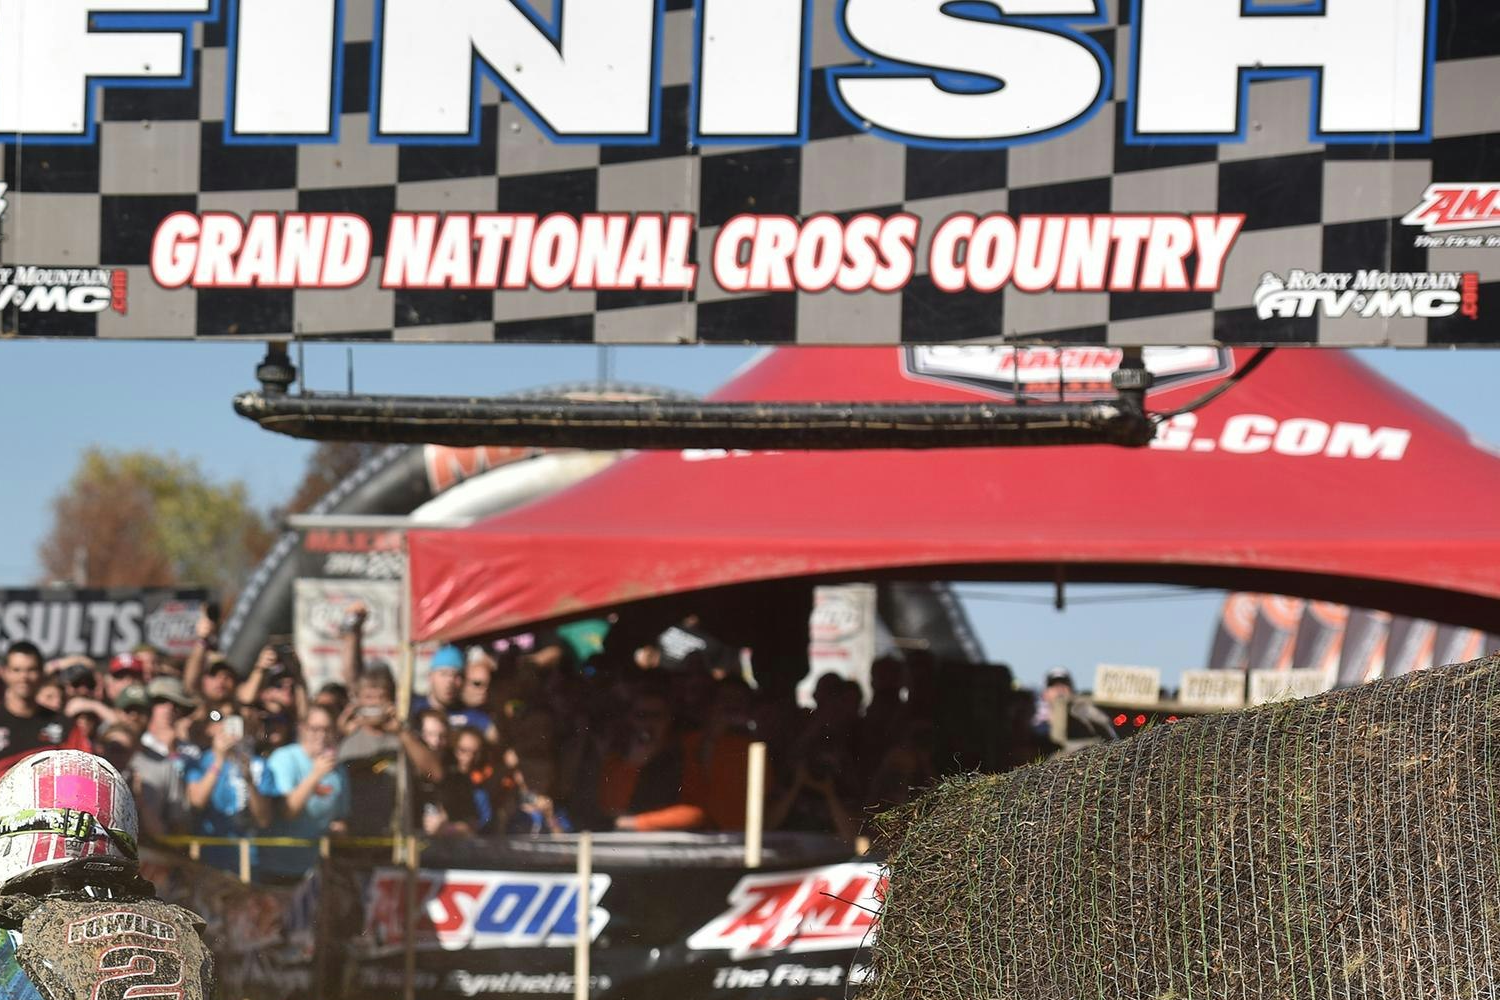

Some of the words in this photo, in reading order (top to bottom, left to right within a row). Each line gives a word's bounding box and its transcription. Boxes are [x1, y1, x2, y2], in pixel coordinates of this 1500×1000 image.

[150, 211, 372, 290] GRAND
[382, 212, 697, 291] NATIONAL
[712, 213, 922, 293] CROSS
[930, 213, 1247, 293] COUNTRY
[14, 265, 113, 286] MOUNTAIN
[1286, 269, 1352, 290] ROCKY
[1353, 269, 1462, 291] MOUNTAIN
[998, 347, 1123, 371] RACIN
[65, 909, 179, 946] FOWLER
[713, 965, 769, 989] The
[770, 962, 844, 987] First
